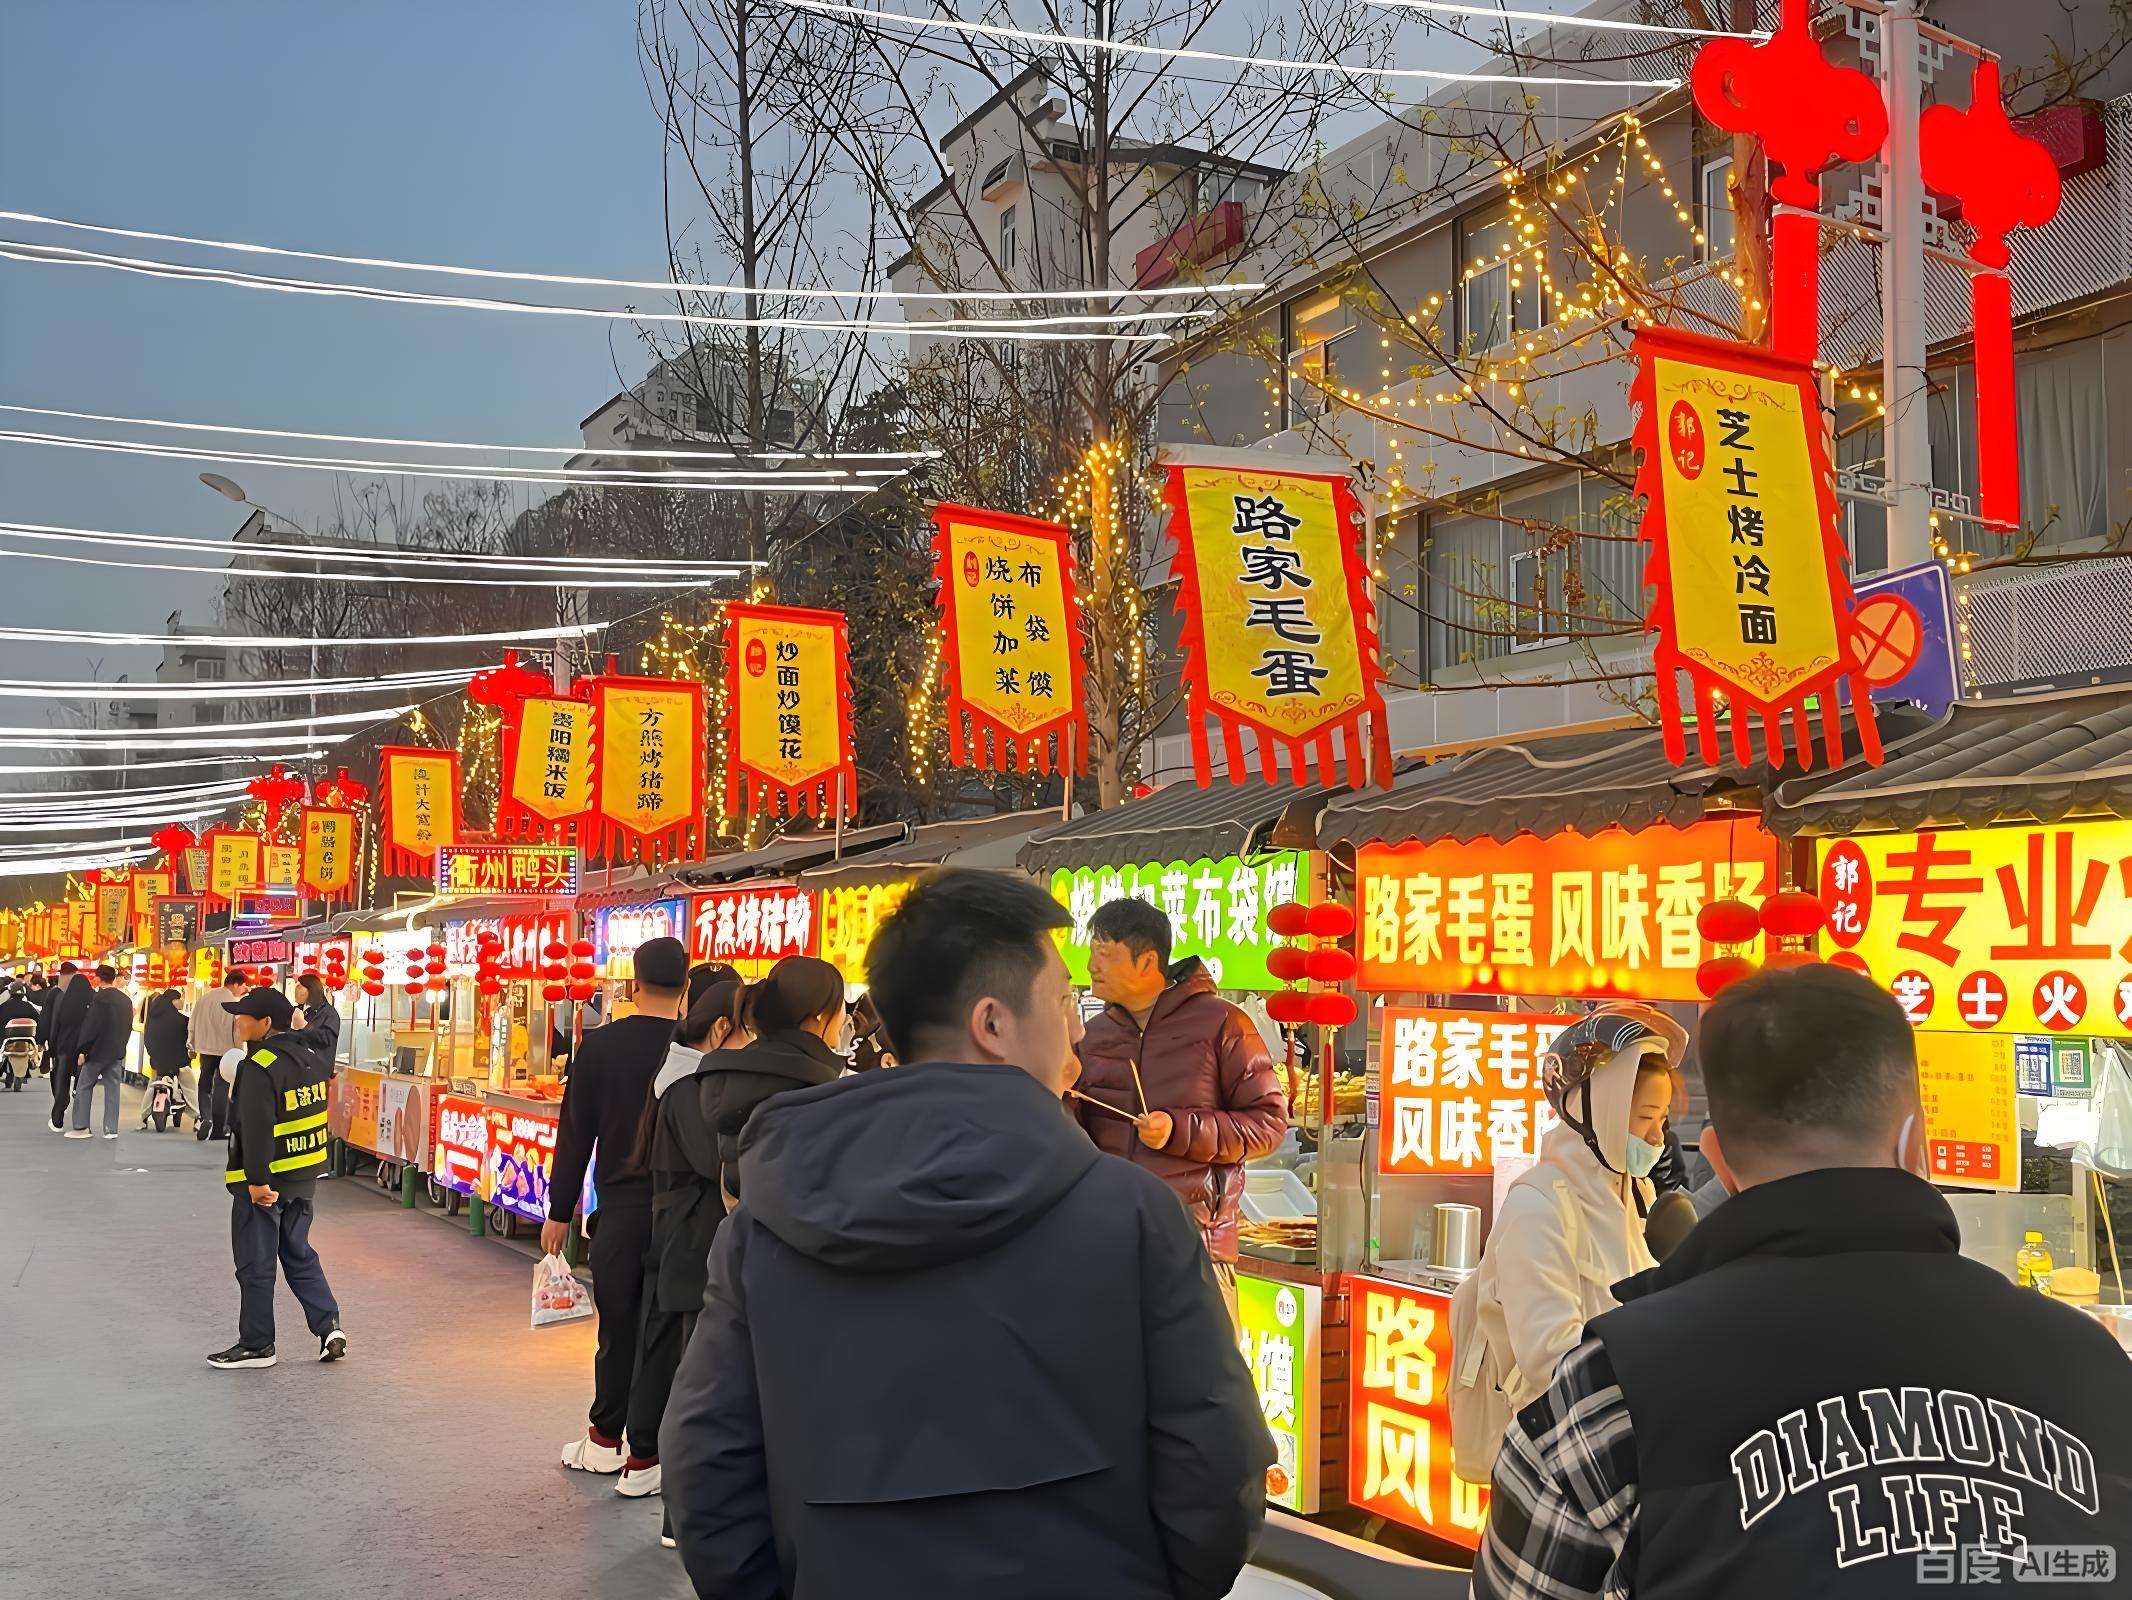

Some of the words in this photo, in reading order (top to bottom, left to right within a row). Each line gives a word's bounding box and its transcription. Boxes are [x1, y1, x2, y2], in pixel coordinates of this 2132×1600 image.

[1716, 408, 1777, 645] 芝士烤冷面
[1017, 561, 1053, 698] 布袋馍
[1231, 494, 1329, 697] 路家毛蛋
[776, 640, 802, 759] 炒面炒馍花
[1363, 872, 1534, 968] 路家毛蛋
[1831, 855, 1861, 933] 郭记
[1876, 832, 2132, 968] 专业
[1730, 1387, 2100, 1530] DIAMOND
[1829, 1474, 2029, 1568] LIFE
